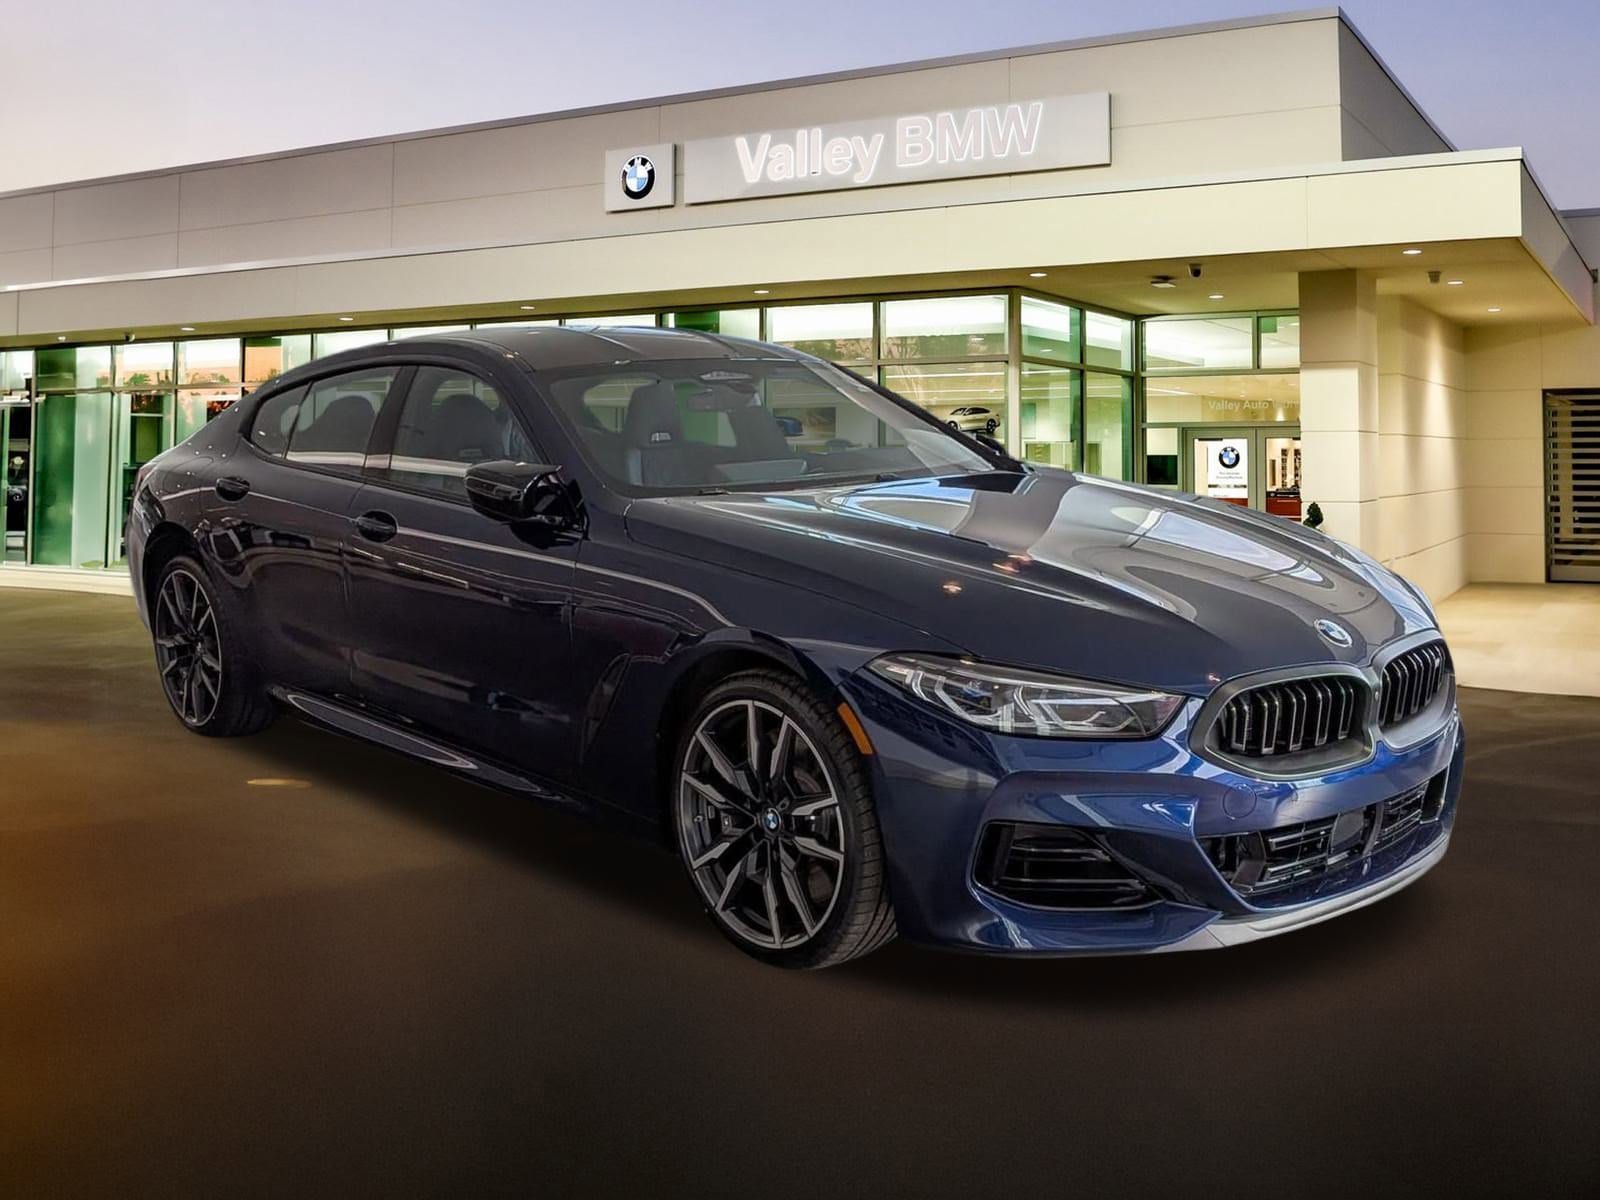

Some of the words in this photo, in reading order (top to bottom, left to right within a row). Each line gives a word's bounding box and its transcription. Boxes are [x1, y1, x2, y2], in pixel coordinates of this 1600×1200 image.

[735, 129, 884, 183] Valley
[896, 103, 1043, 169] BMW
[1208, 401, 1240, 411] Valley
[1243, 400, 1270, 409] Auto
